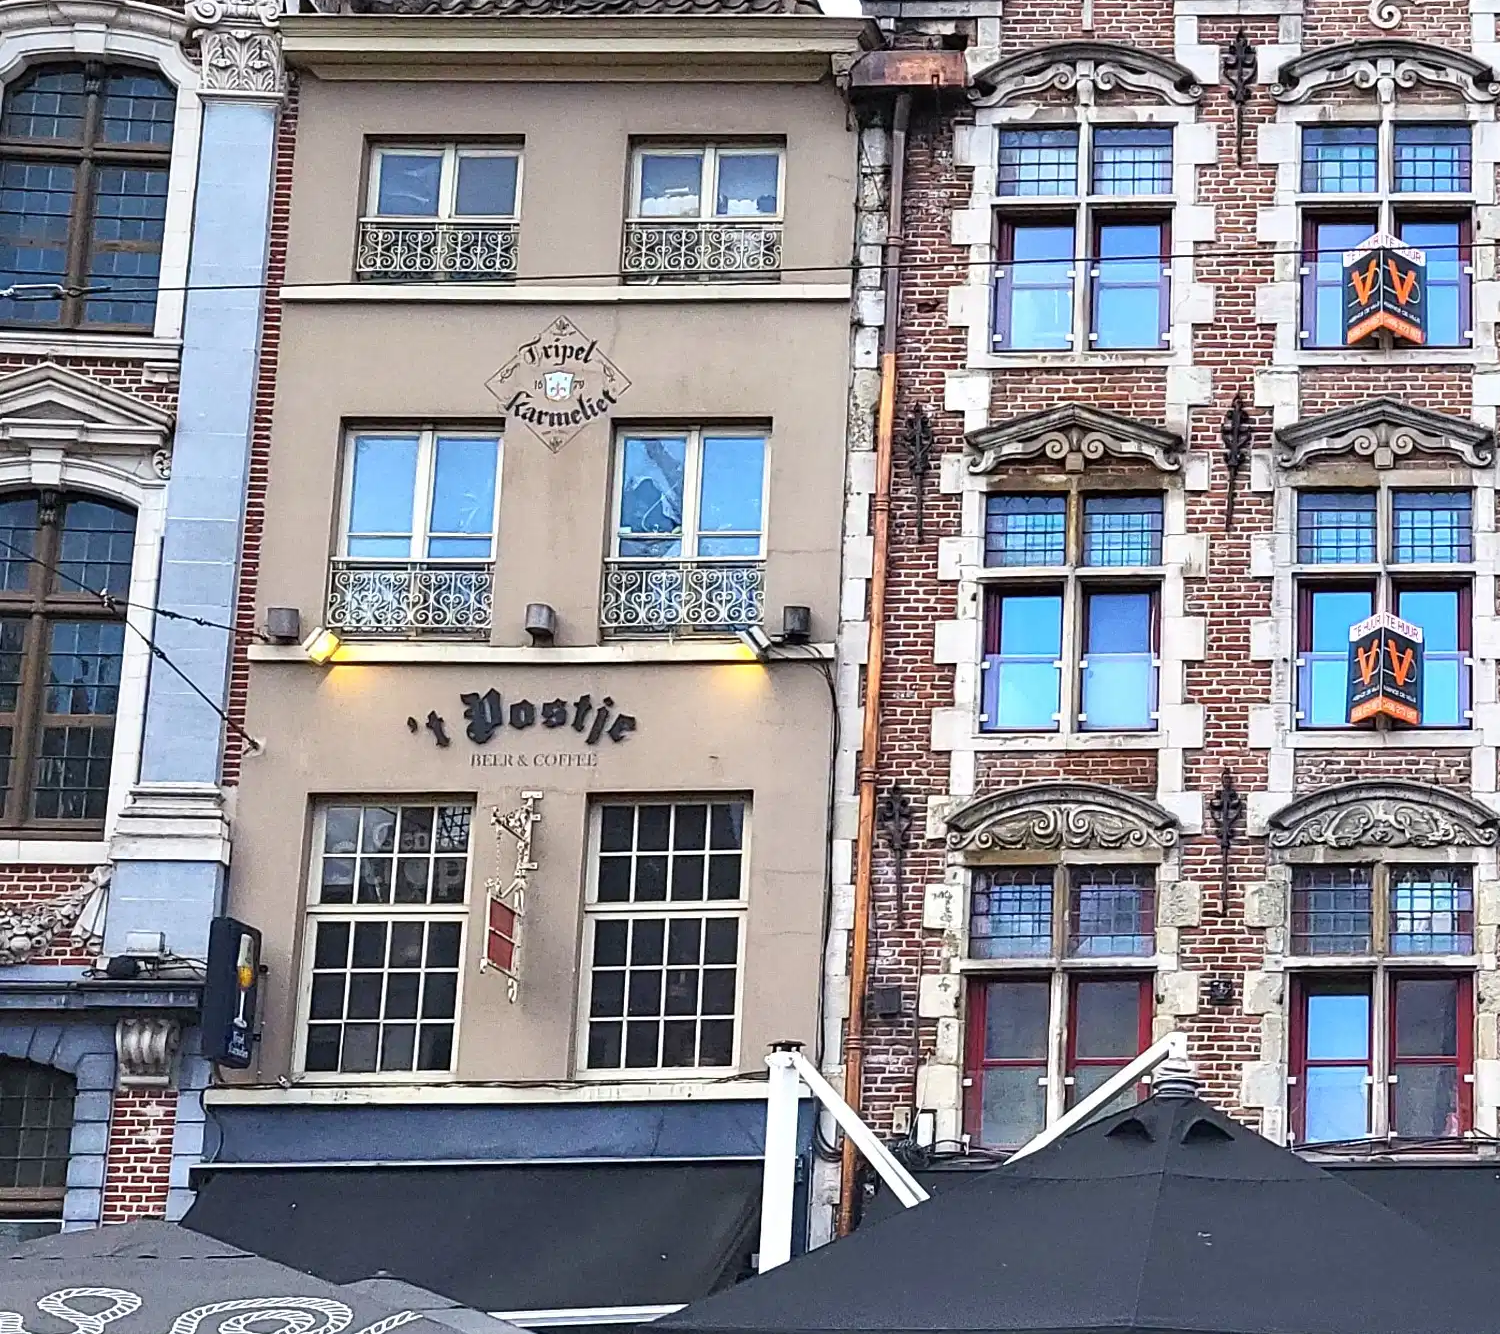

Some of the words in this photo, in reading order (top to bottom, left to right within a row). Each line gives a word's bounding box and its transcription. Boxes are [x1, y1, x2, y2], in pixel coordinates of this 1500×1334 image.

[519, 333, 598, 366] Tripel
[504, 389, 617, 427] Karmeliet
[459, 687, 637, 745] Postje
[470, 752, 513, 767] BEER
[516, 753, 529, 767] &
[533, 753, 598, 767] COFFEE
